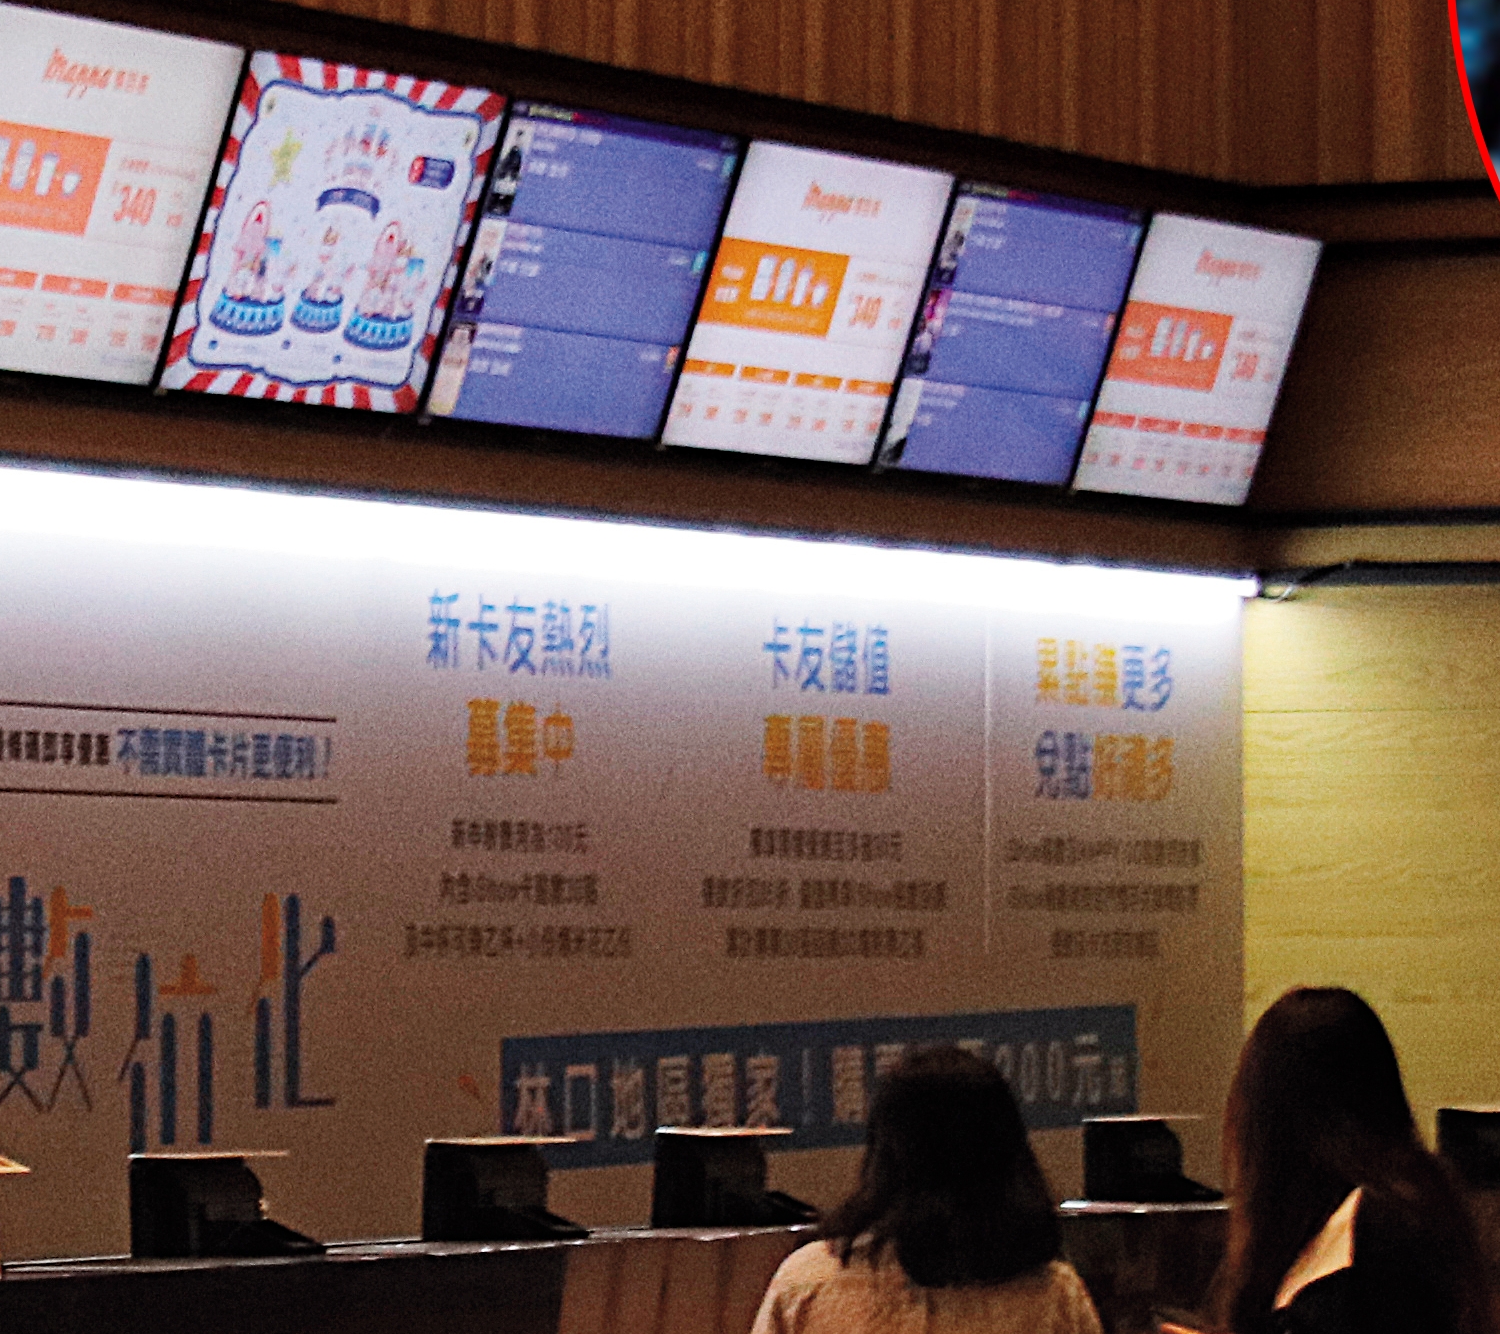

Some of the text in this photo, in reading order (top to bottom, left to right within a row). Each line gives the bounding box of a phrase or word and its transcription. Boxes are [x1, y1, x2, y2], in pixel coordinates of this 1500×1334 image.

[426, 589, 613, 679] 新卡友熱烈
[763, 618, 891, 695] 卡友儲值
[466, 697, 575, 776] 募集中
